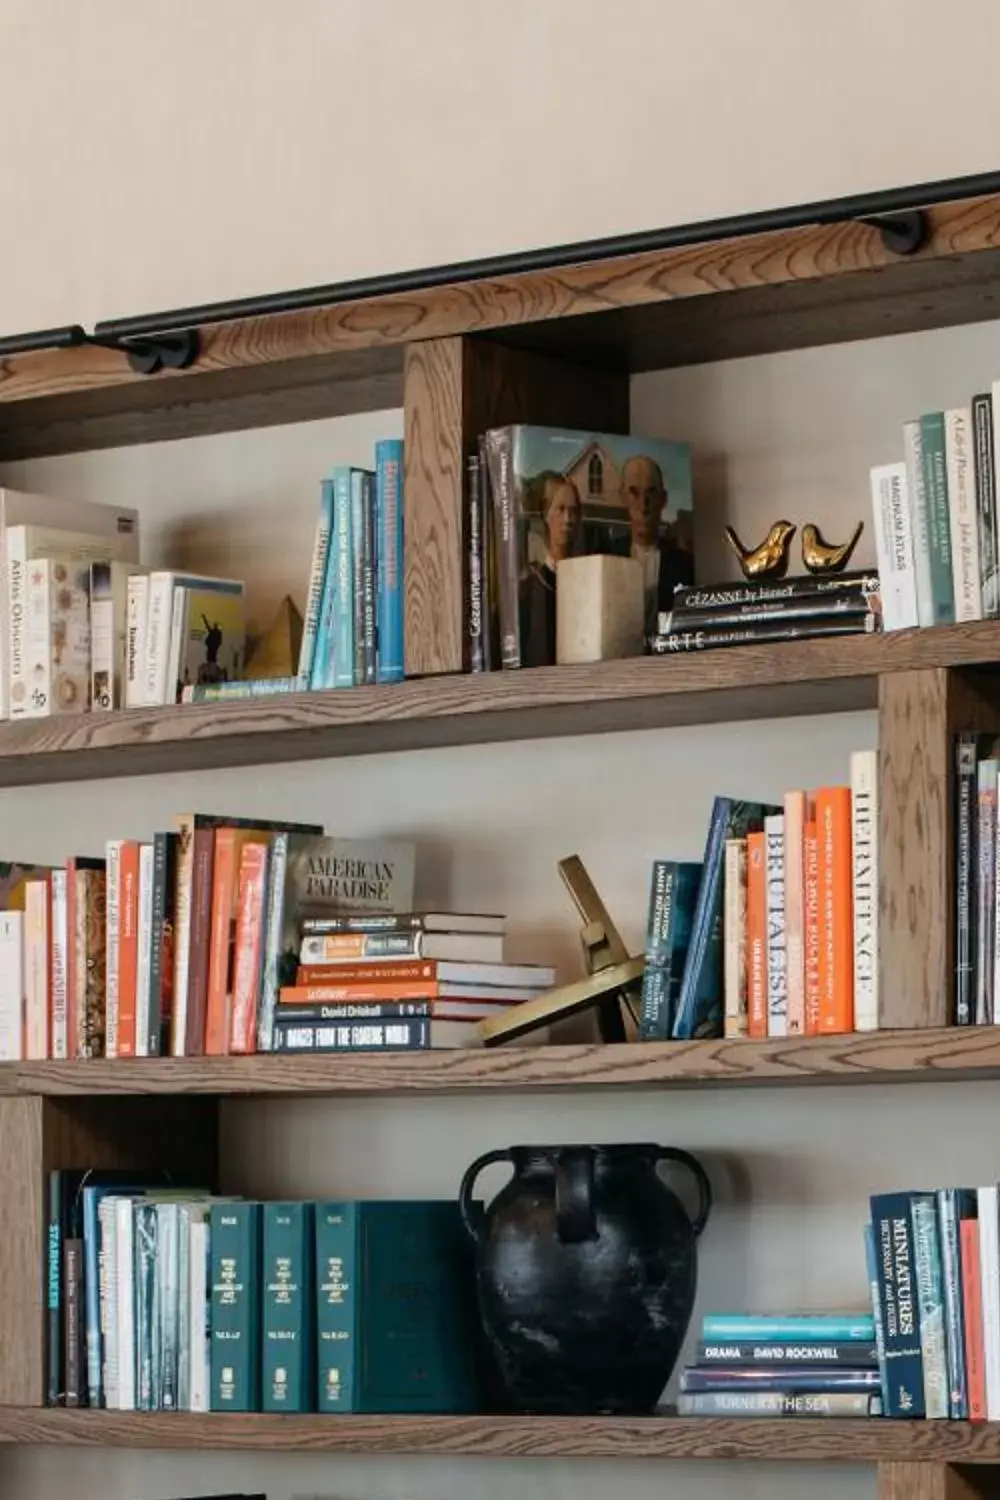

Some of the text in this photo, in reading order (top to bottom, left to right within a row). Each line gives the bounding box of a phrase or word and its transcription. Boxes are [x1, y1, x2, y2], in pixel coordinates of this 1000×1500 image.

[891, 475, 907, 571] MAGNUM ATLAS
[308, 857, 395, 881] AMERICAN
[306, 877, 391, 900] PARADISE
[768, 832, 787, 1018] BRUTALISM
[321, 1004, 347, 1019] David
[880, 1219, 896, 1280] DICTIONARY
[49, 1224, 60, 1309] STARMAKER
[893, 1217, 914, 1335] MINIATURES
[884, 1282, 896, 1300] and
[704, 1347, 839, 1359] DRAMA DAVID ROCKWELL
[777, 1397, 803, 1411] THE
[804, 1398, 830, 1411] SEA
